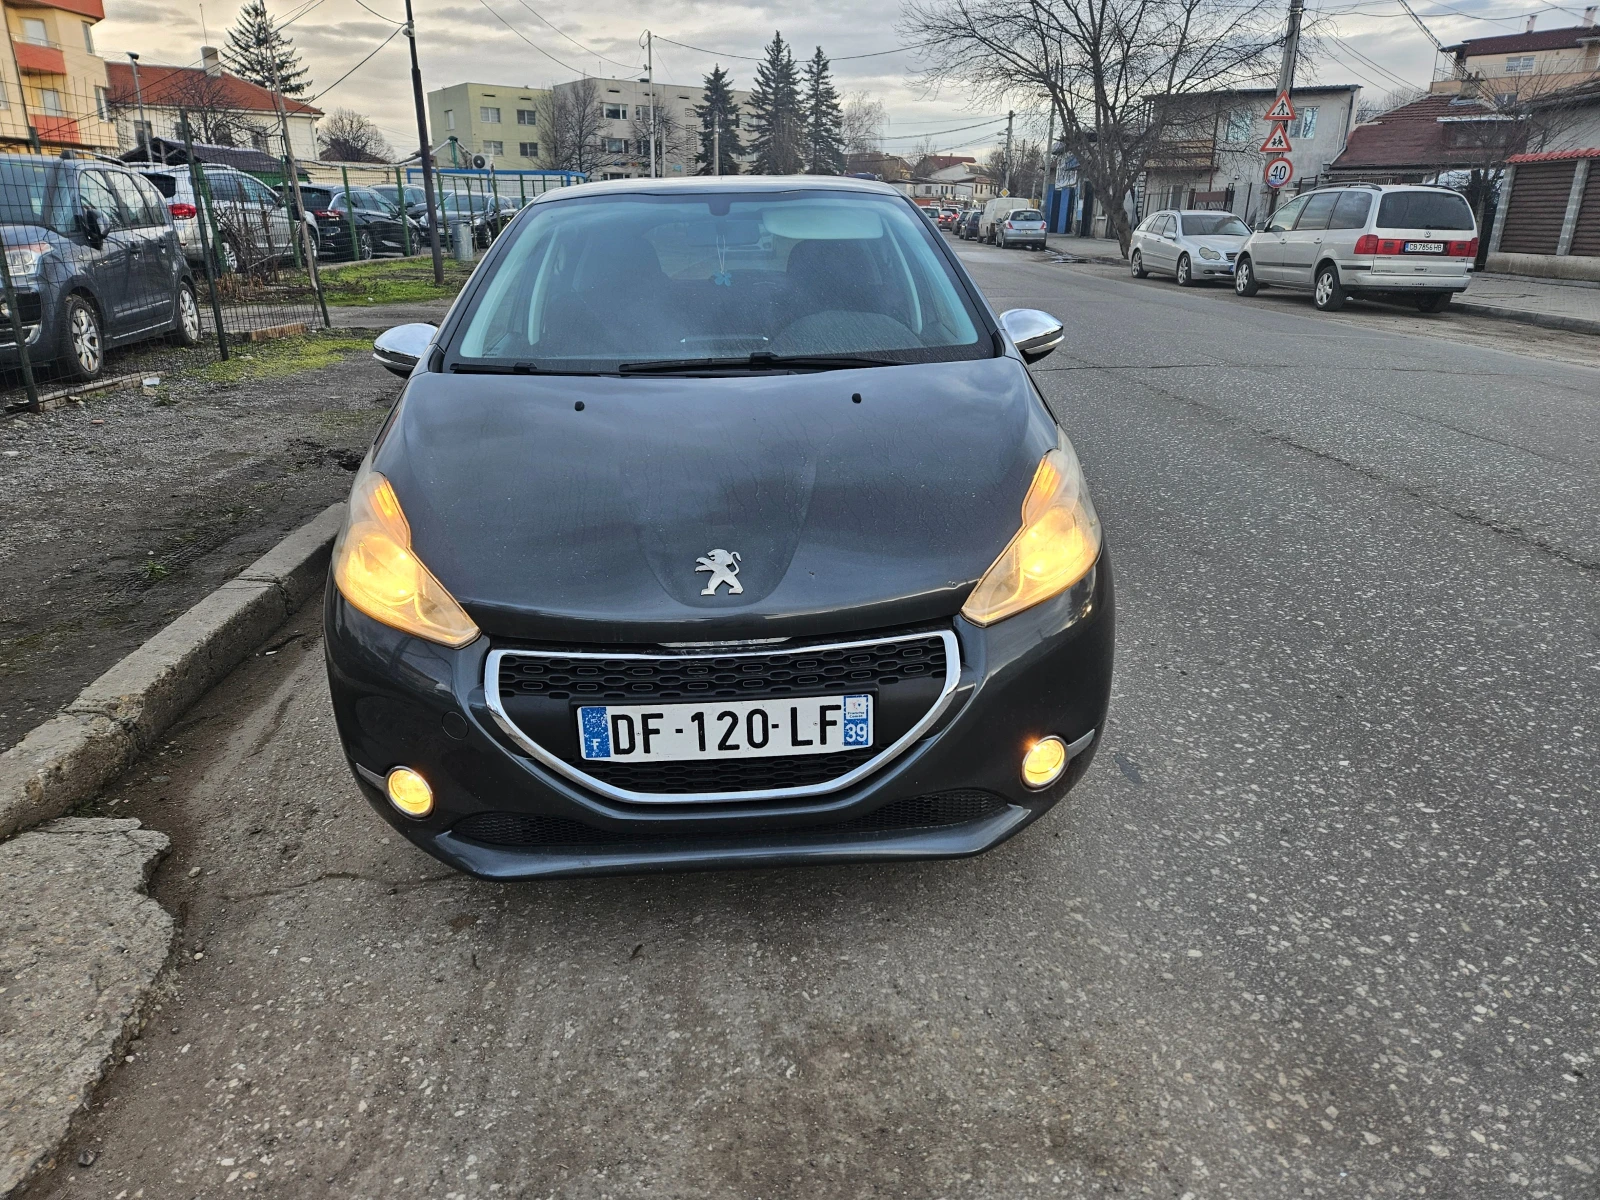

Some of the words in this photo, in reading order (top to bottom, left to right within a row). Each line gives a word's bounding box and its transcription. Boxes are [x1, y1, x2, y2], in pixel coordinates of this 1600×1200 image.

[1271, 165, 1287, 180] 40
[845, 723, 867, 743] 39
[590, 738, 601, 751] F
